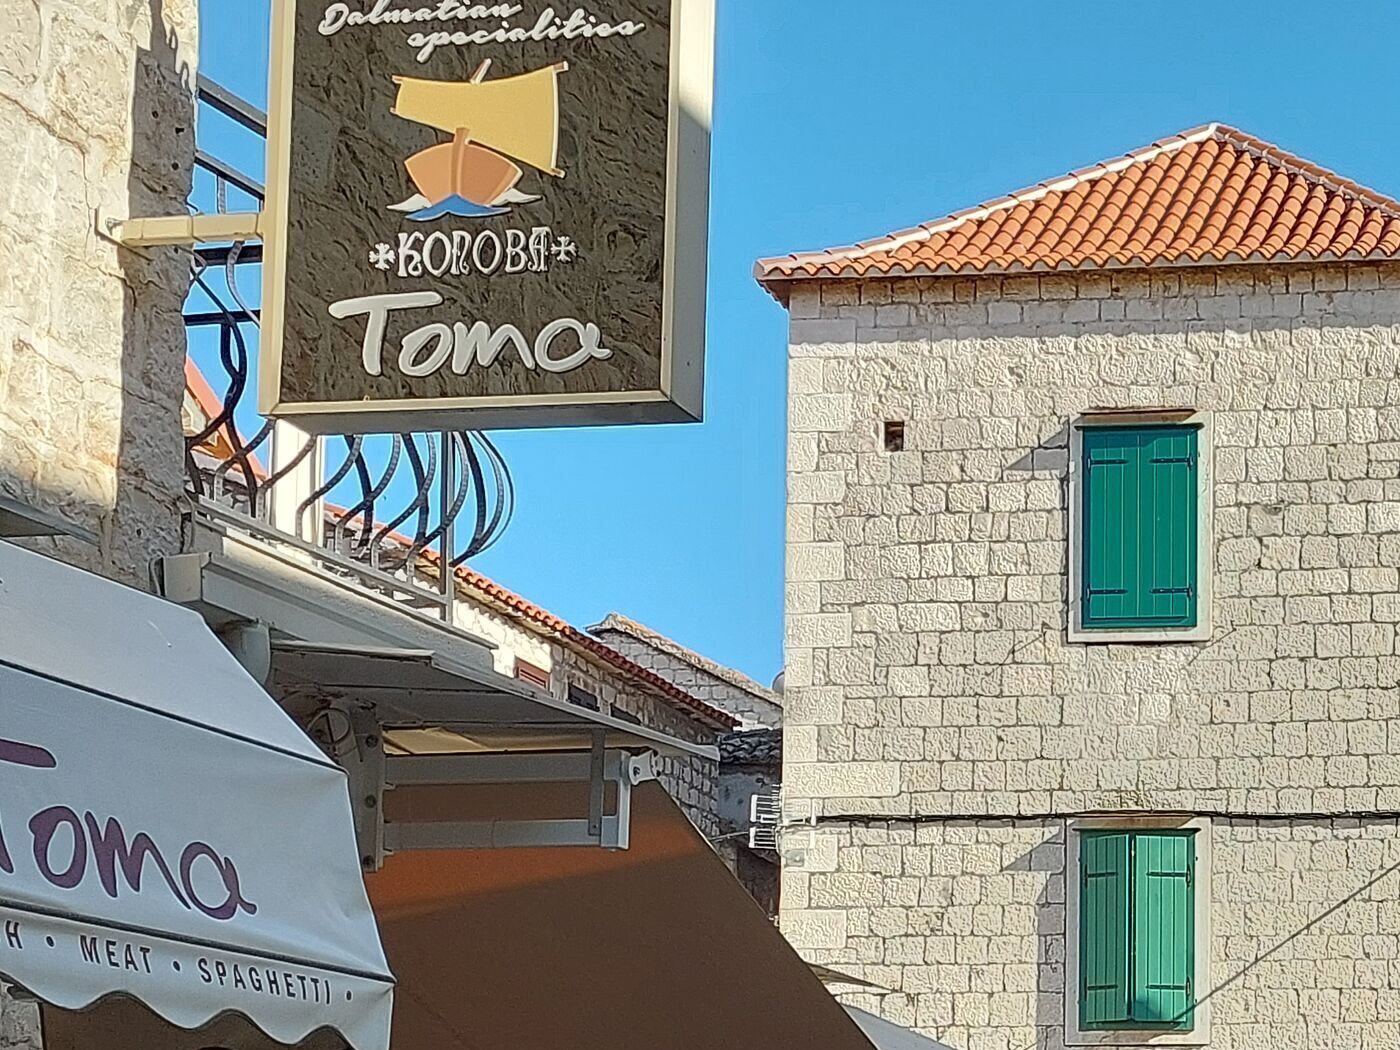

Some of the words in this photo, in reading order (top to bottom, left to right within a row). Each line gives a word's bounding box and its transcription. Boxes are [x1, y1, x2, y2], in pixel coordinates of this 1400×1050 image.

[318, 0, 523, 35] Dalmatian
[407, 8, 645, 63] specialities
[328, 291, 612, 377] Toma
[80, 935, 152, 973] MEAT
[198, 957, 332, 1004] SPAGHETTI
